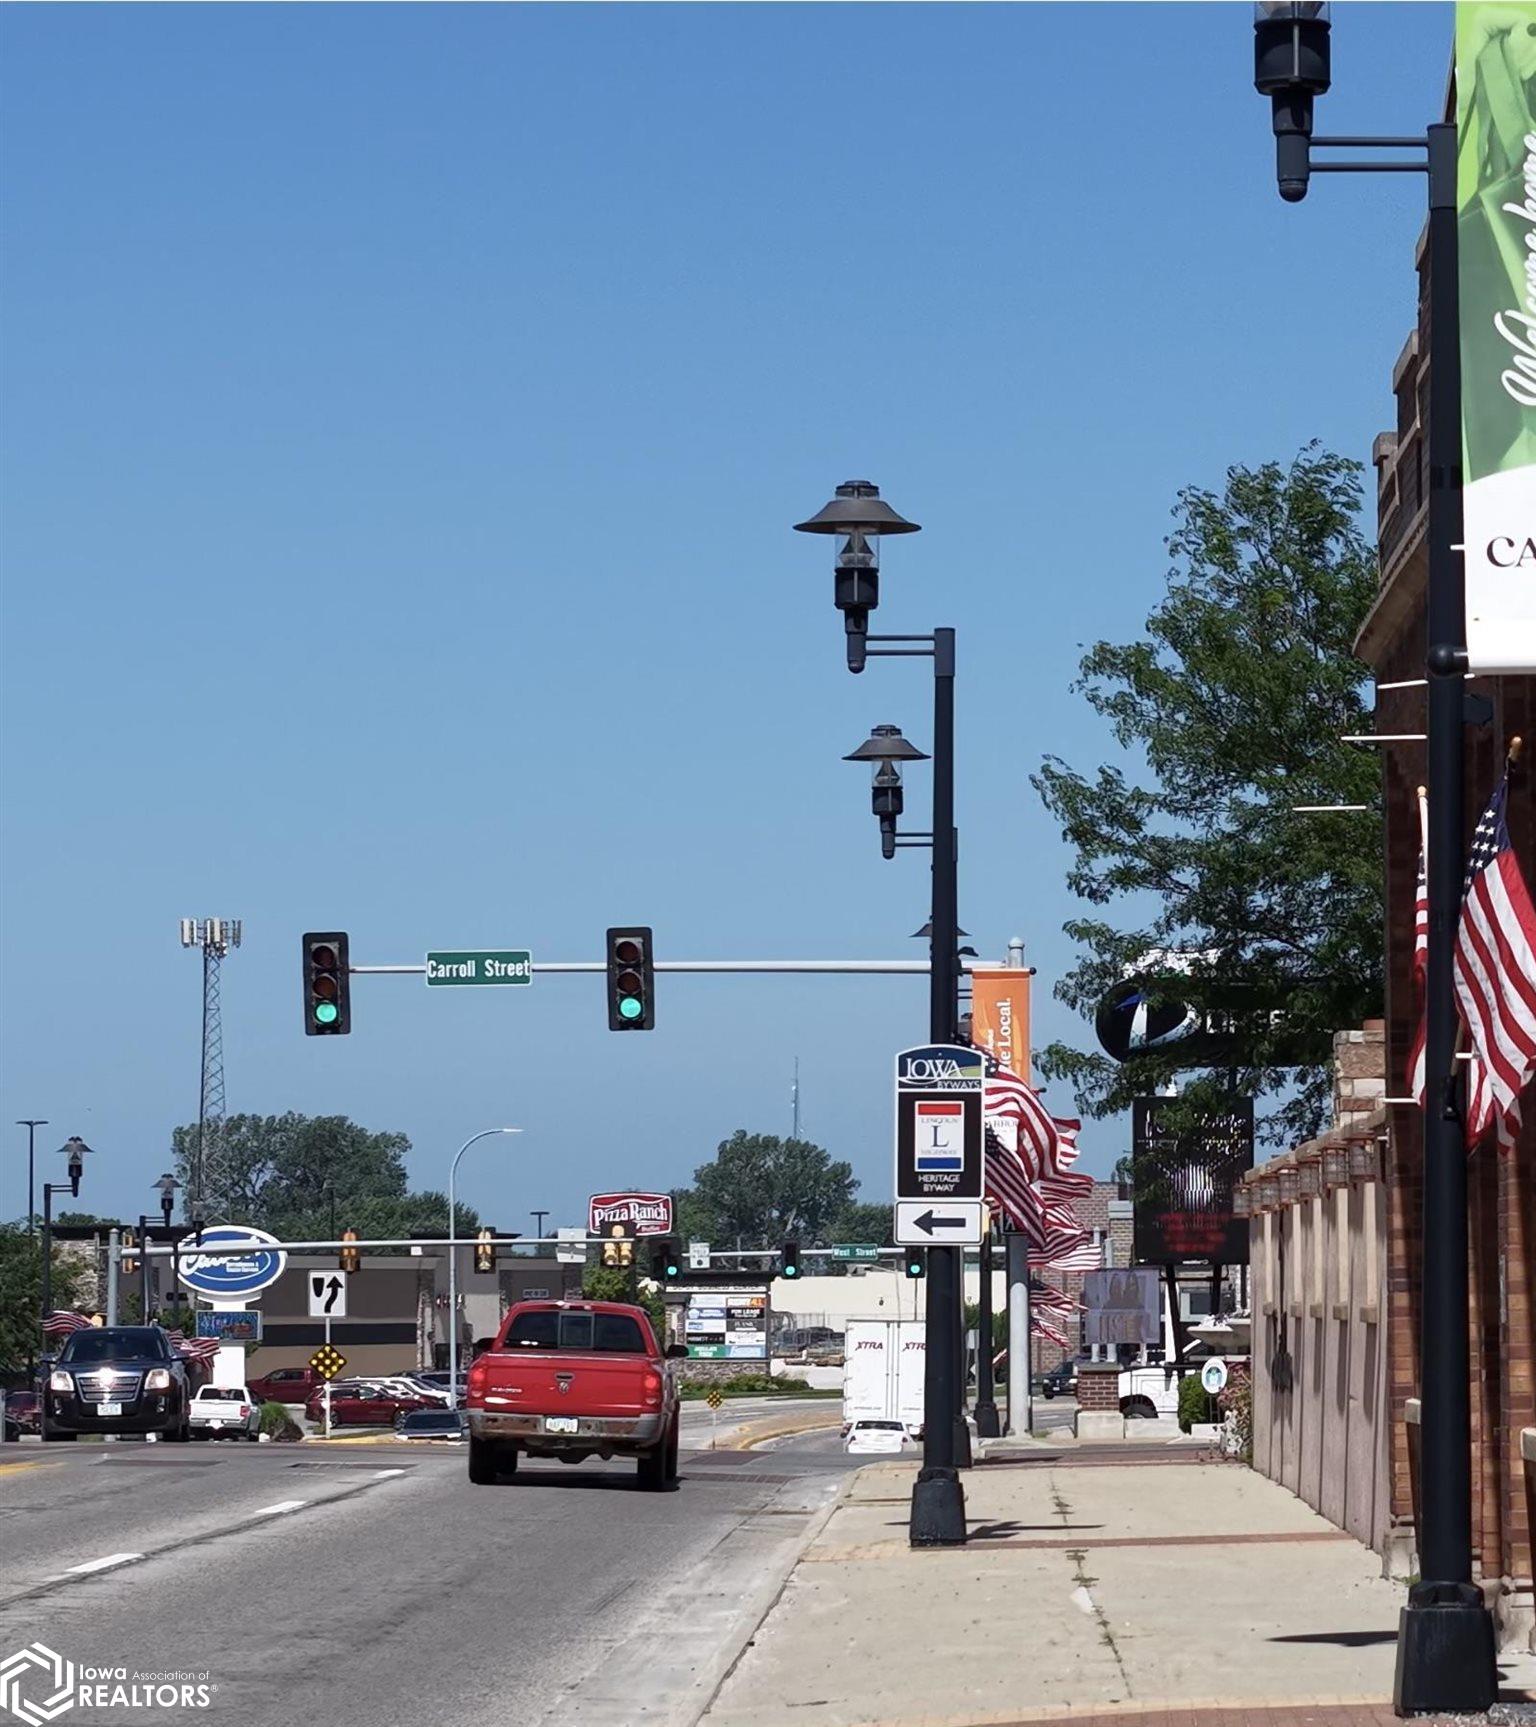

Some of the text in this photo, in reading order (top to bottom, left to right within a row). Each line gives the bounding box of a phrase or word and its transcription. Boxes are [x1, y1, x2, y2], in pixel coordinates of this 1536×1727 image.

[427, 959, 530, 978] Carroll Street
[906, 1058, 963, 1078] IOWA
[937, 1080, 981, 1089] BYWAYS
[931, 1125, 950, 1148] L
[918, 1174, 961, 1183] HERITAGE
[922, 1183, 956, 1192] BYWAY
[593, 1202, 669, 1227] Pizza Ranch
[833, 1247, 877, 1257] West Street
[854, 1341, 884, 1352] XTRA
